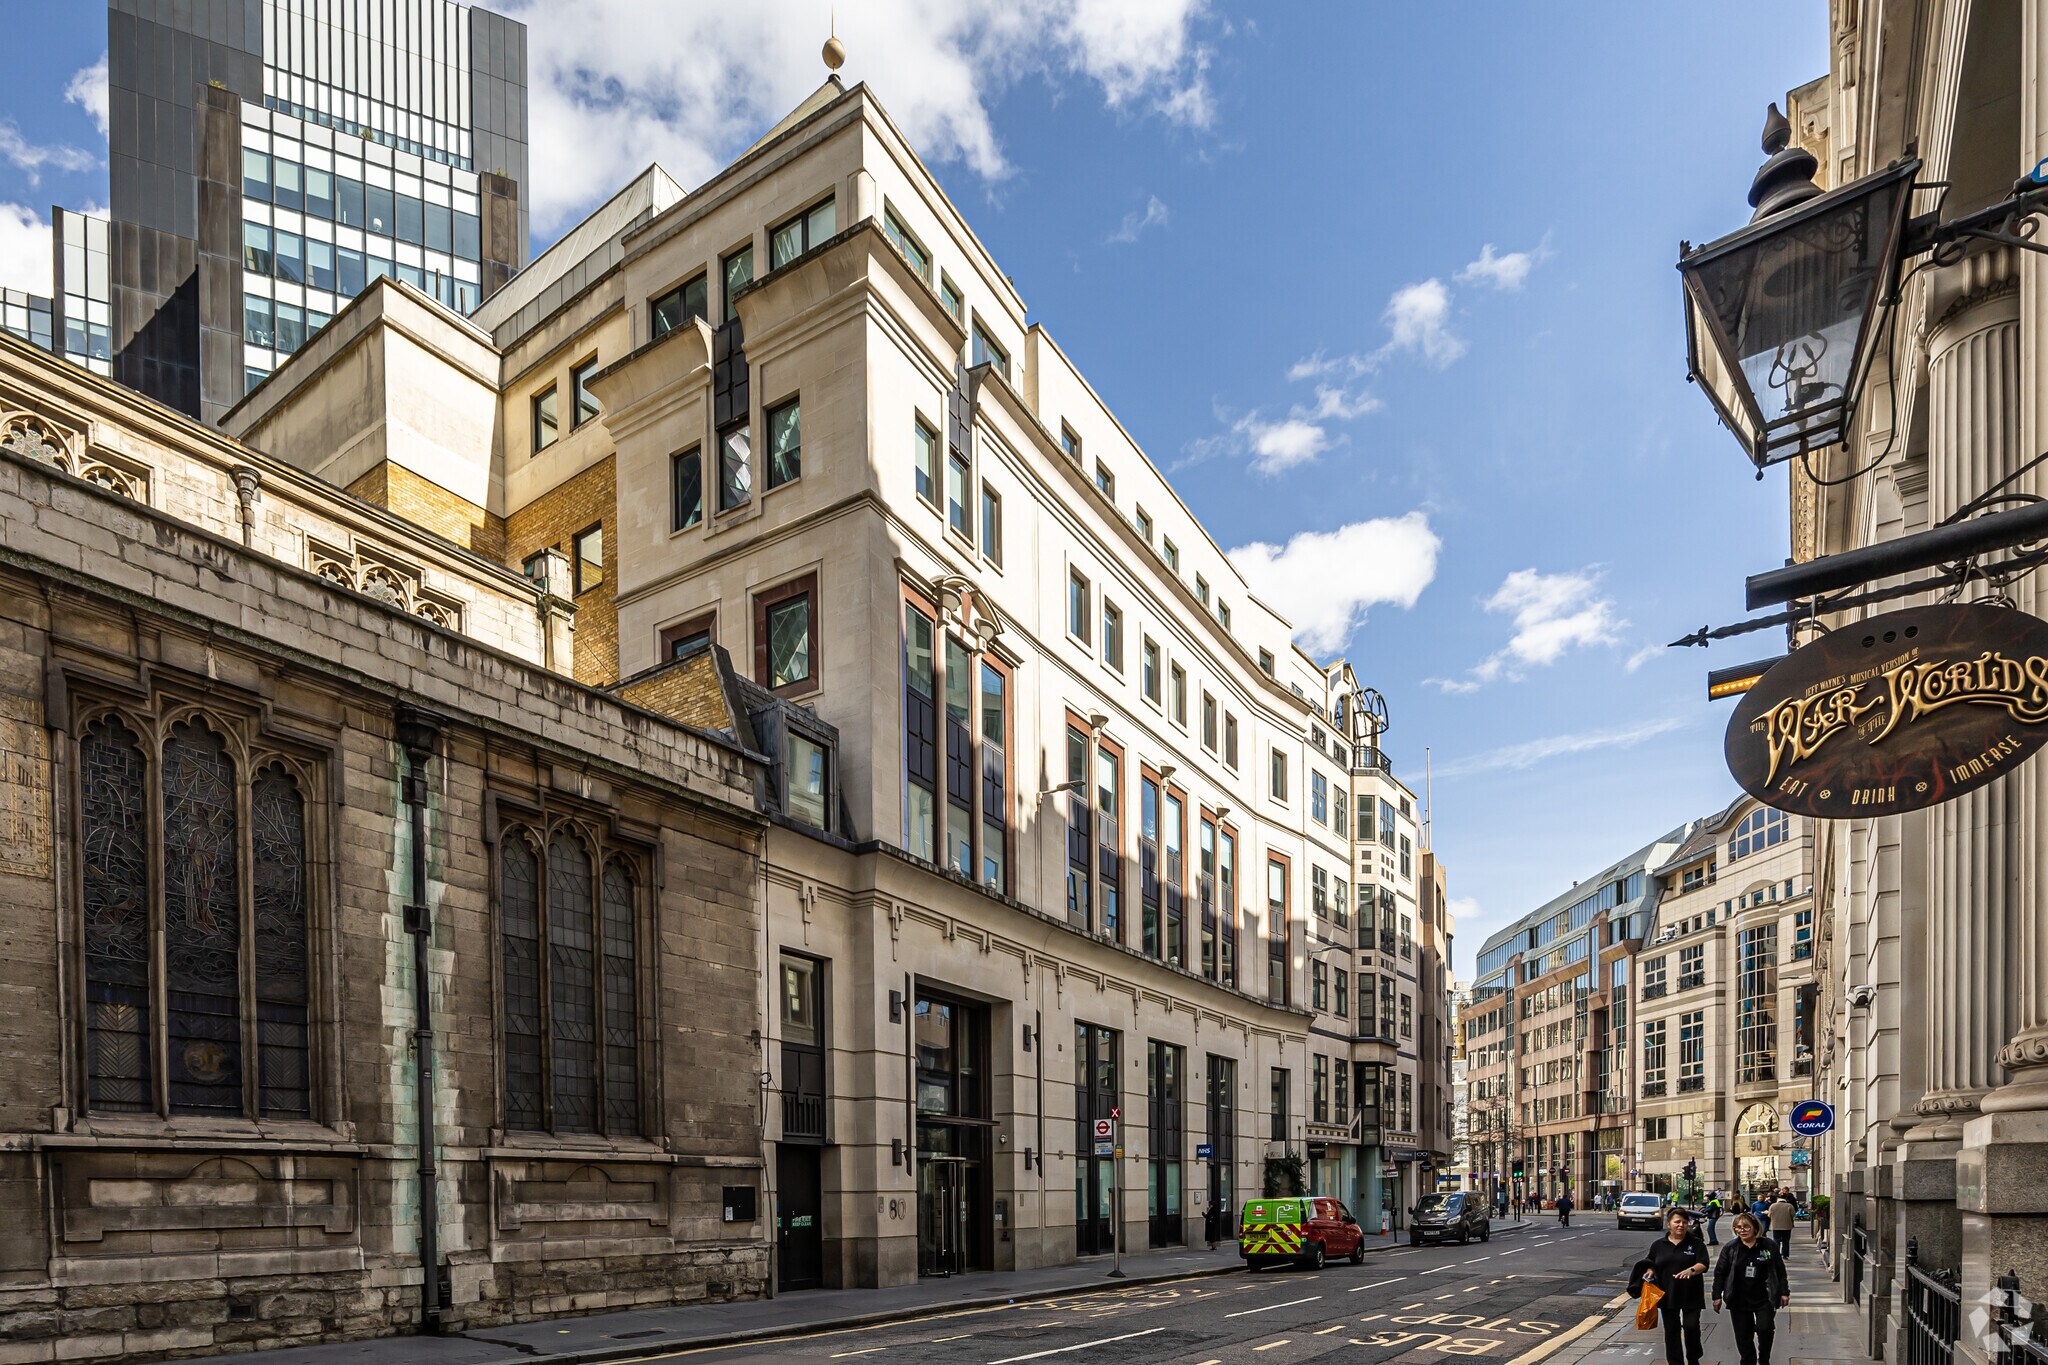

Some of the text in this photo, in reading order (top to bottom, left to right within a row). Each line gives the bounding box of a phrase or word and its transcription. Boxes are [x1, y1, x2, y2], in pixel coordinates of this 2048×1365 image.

[1805, 685, 1819, 697] JEFF
[1820, 674, 1846, 690] WAYNE'S
[1850, 667, 1880, 684] MUSICAL
[1880, 652, 1909, 673] VERSION
[1869, 651, 2048, 745] WORLDS
[1750, 721, 1766, 734] THE
[1867, 714, 1887, 732] THE
[1752, 682, 1885, 788] WAR
[1779, 775, 1808, 797] EAT
[1949, 734, 2022, 784] IMMERSE
[1750, 1139, 1762, 1151] 90
[889, 1199, 907, 1220] 80
[1391, 1313, 1561, 1335] STOP
[1349, 1331, 1506, 1355] BUS
